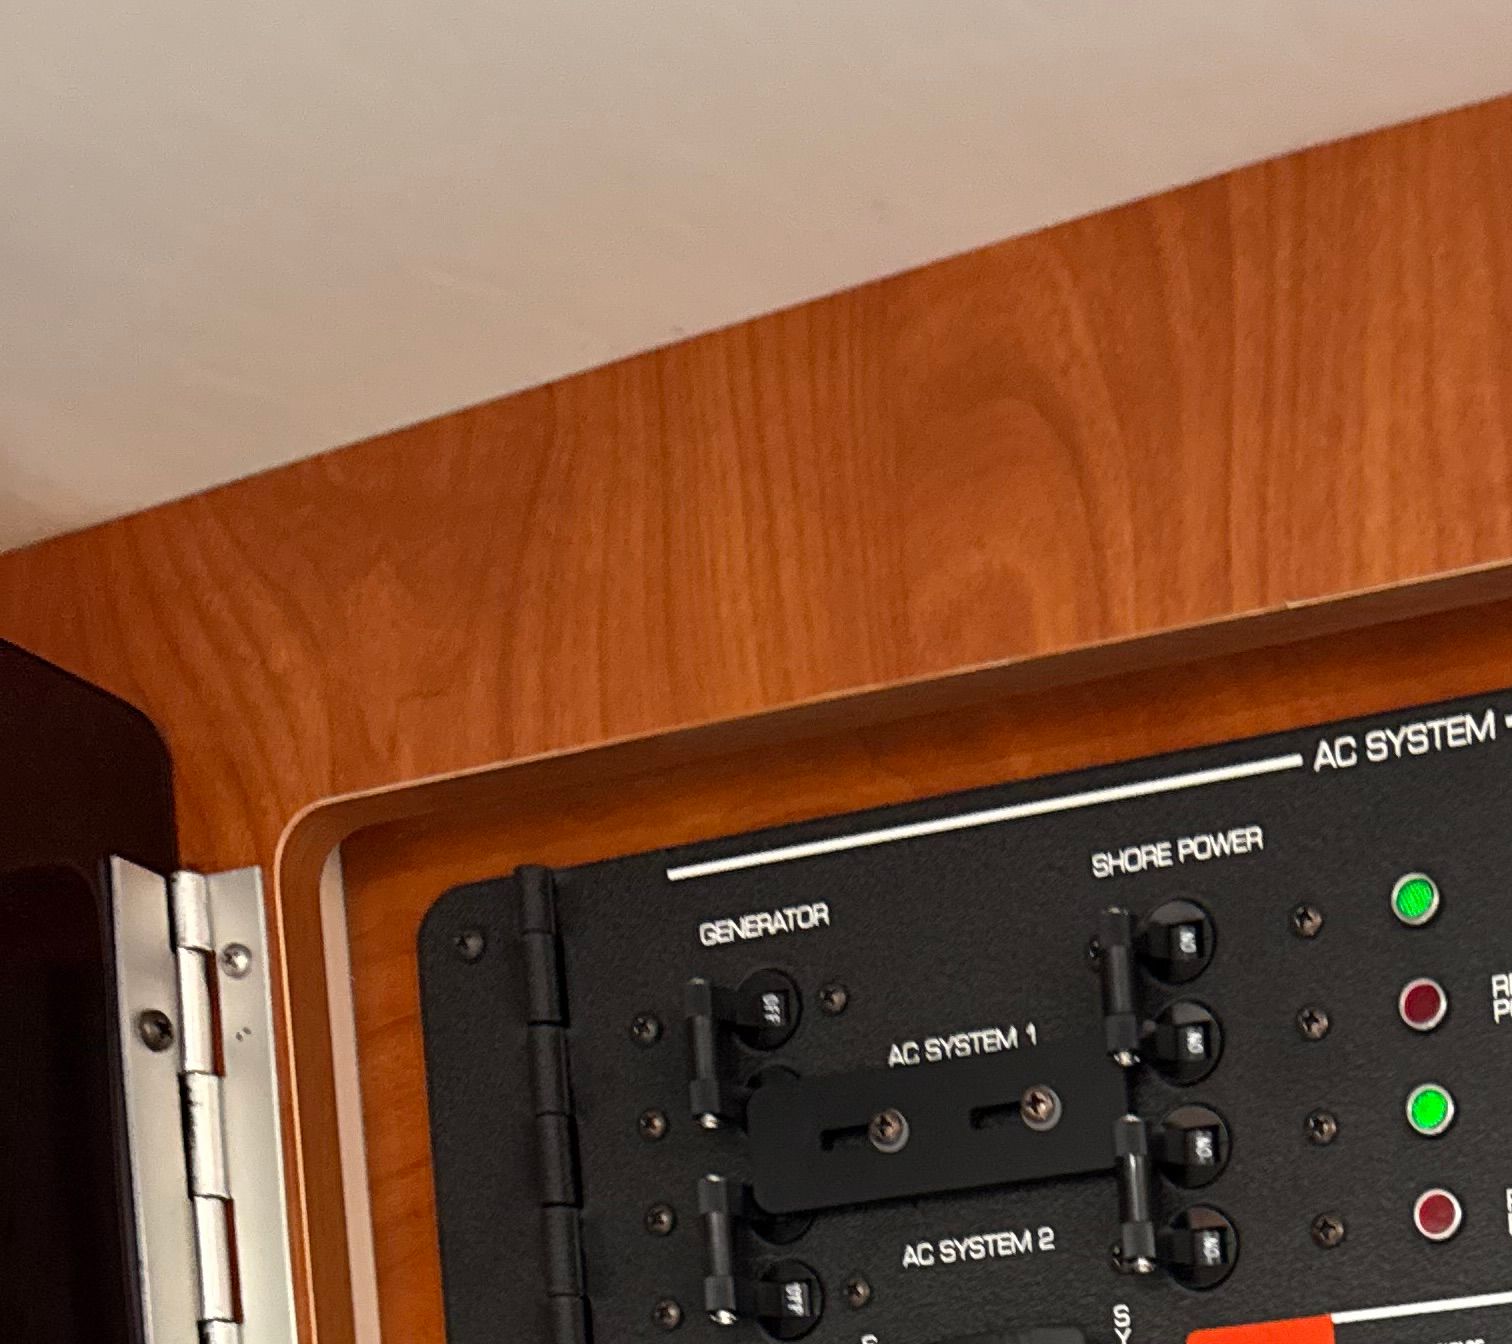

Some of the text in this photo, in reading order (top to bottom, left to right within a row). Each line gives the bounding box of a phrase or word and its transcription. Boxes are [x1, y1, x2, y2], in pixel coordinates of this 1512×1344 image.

[1313, 709, 1496, 772] AC SYSTEM
[1091, 826, 1264, 878] SHORE POWER
[699, 902, 830, 947] GENERATOR
[887, 1023, 1037, 1067] AC SYSTEM 1
[902, 1226, 1056, 1269] AC SYSTEM 2
